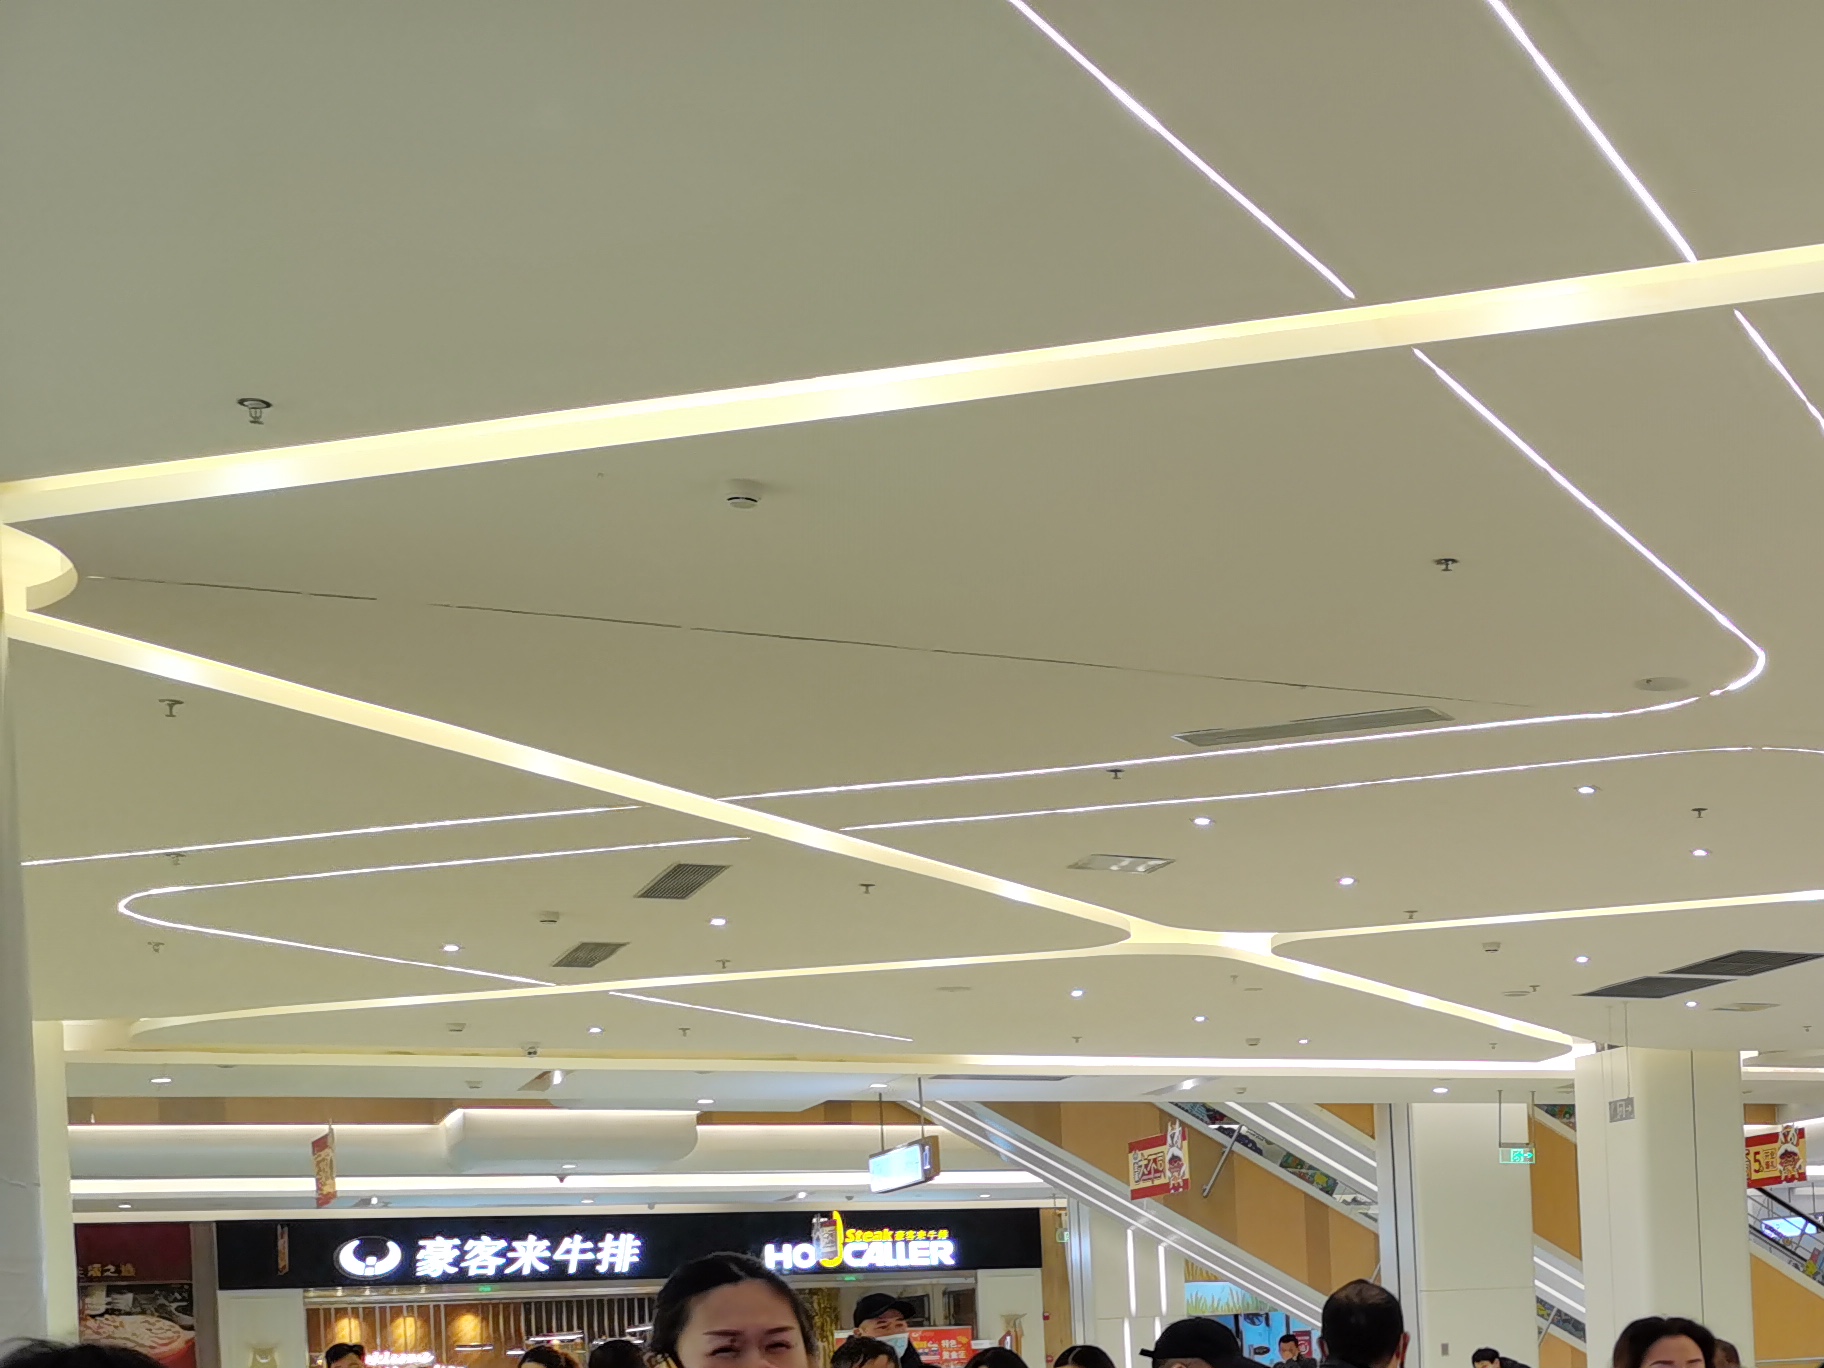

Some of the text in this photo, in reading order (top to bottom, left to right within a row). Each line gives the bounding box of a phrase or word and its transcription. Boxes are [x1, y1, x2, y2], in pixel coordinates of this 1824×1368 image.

[844, 1228, 894, 1242] Steak
[414, 1232, 642, 1278] 豪客来牛排
